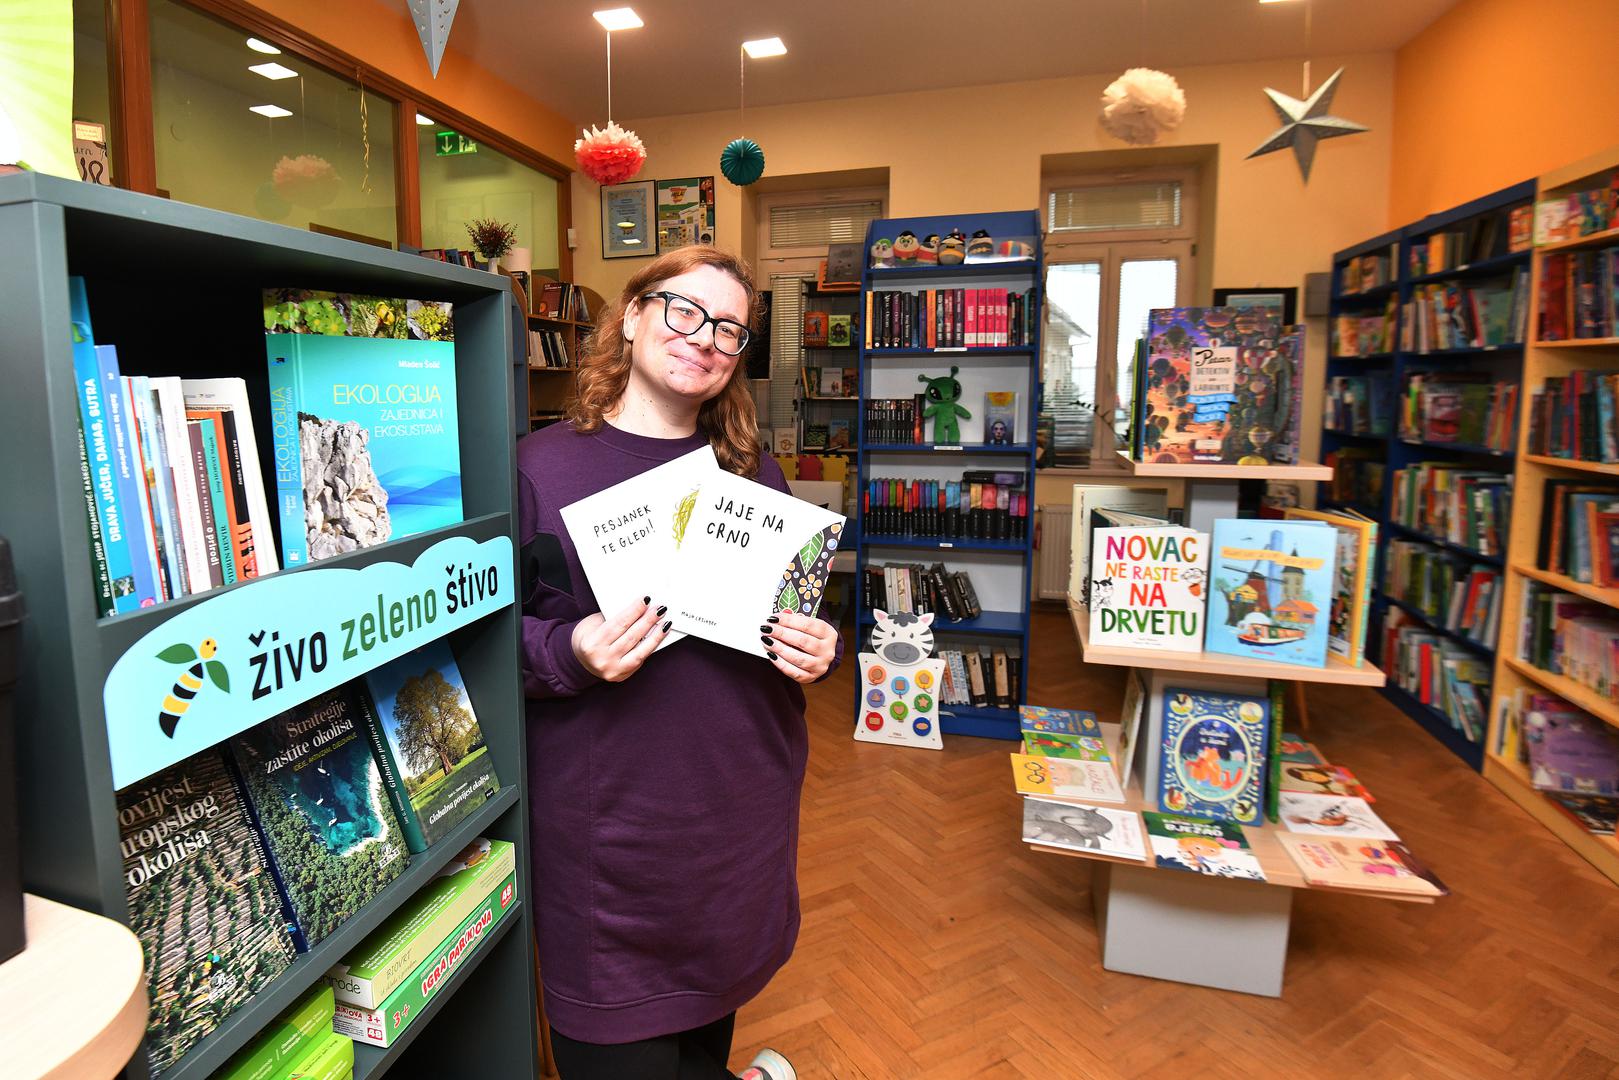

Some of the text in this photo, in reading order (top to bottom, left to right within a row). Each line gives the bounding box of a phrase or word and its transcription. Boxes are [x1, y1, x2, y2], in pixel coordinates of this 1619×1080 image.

[399, 360, 423, 369] Mladen
[333, 384, 442, 405] EKOLOGIJA
[374, 423, 444, 438] EKOSUSTAVA
[381, 409, 437, 422] ZAJEDNICA
[271, 387, 292, 483] EKOLOGIJA
[86, 378, 121, 543] DRAVA JUČER, DANAS, SUTRA
[593, 504, 652, 538] PESJANEK
[715, 496, 785, 533] JAJE NA
[601, 518, 656, 555] TE GLEDI!
[706, 522, 750, 548] CRNO
[1105, 535, 1198, 564] NOVAC
[220, 525, 235, 584] VIDRIN REVIR
[1105, 562, 1179, 582] NE RASTE
[1129, 582, 1168, 608] NA
[249, 563, 499, 701] živo zeleno štivo
[1100, 607, 1198, 637] DRVETU
[286, 700, 347, 738] Strategije
[265, 717, 354, 774] zaštite okoliša
[368, 723, 386, 754] povijest
[380, 754, 396, 789] Globalna
[119, 775, 192, 826] ovijest
[429, 801, 454, 825] Globalna
[453, 785, 473, 808] povijest
[128, 829, 212, 887] okoliša
[250, 826, 269, 869] Strategije
[422, 956, 447, 997] IGRA
[448, 909, 493, 969] PAR(K)OVA
